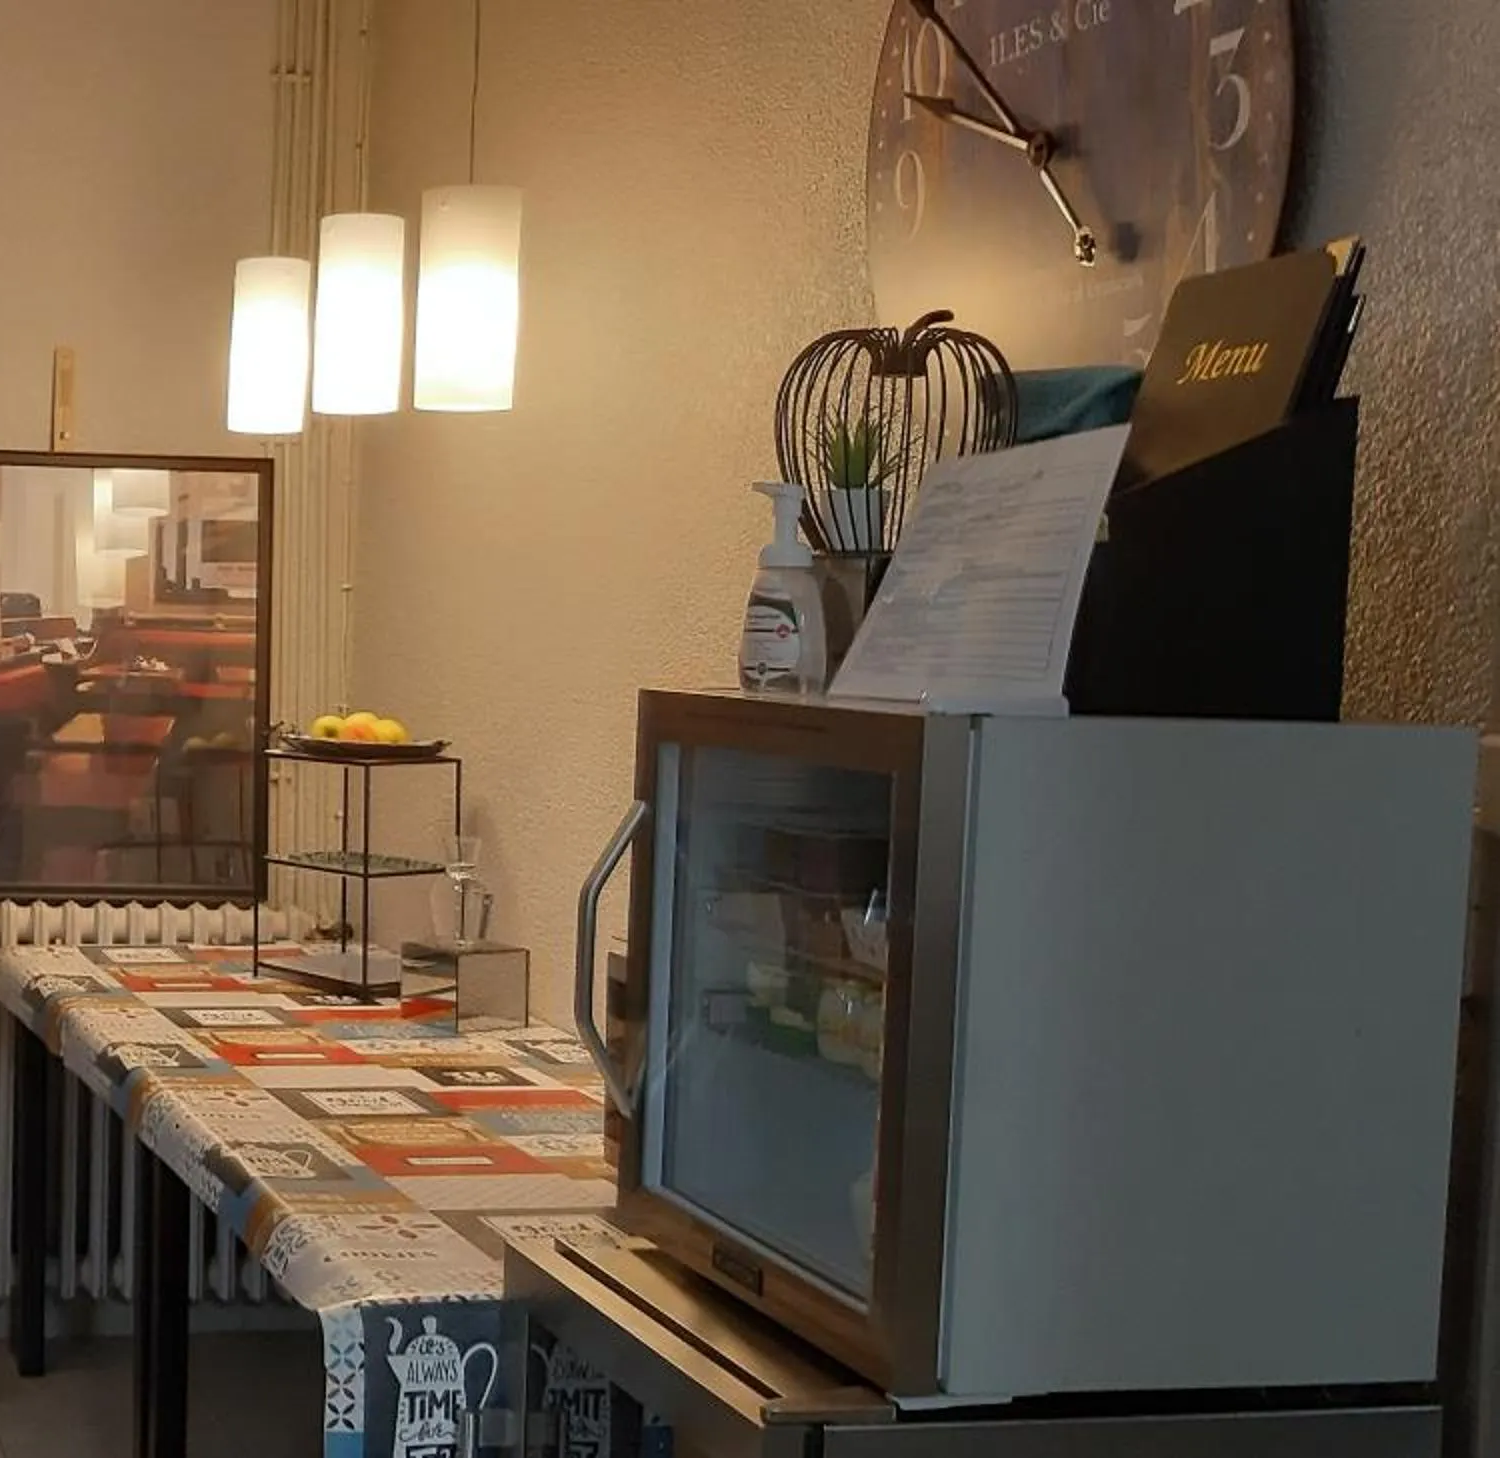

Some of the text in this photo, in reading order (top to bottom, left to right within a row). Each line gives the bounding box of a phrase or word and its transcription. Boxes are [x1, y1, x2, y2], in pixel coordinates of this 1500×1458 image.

[901, 17, 947, 123] 10
[1208, 27, 1251, 151] 3
[895, 150, 925, 242] 9
[1176, 339, 1269, 385] Menu
[404, 1388, 462, 1425] TIME
[406, 1359, 459, 1385] ALWAYS
